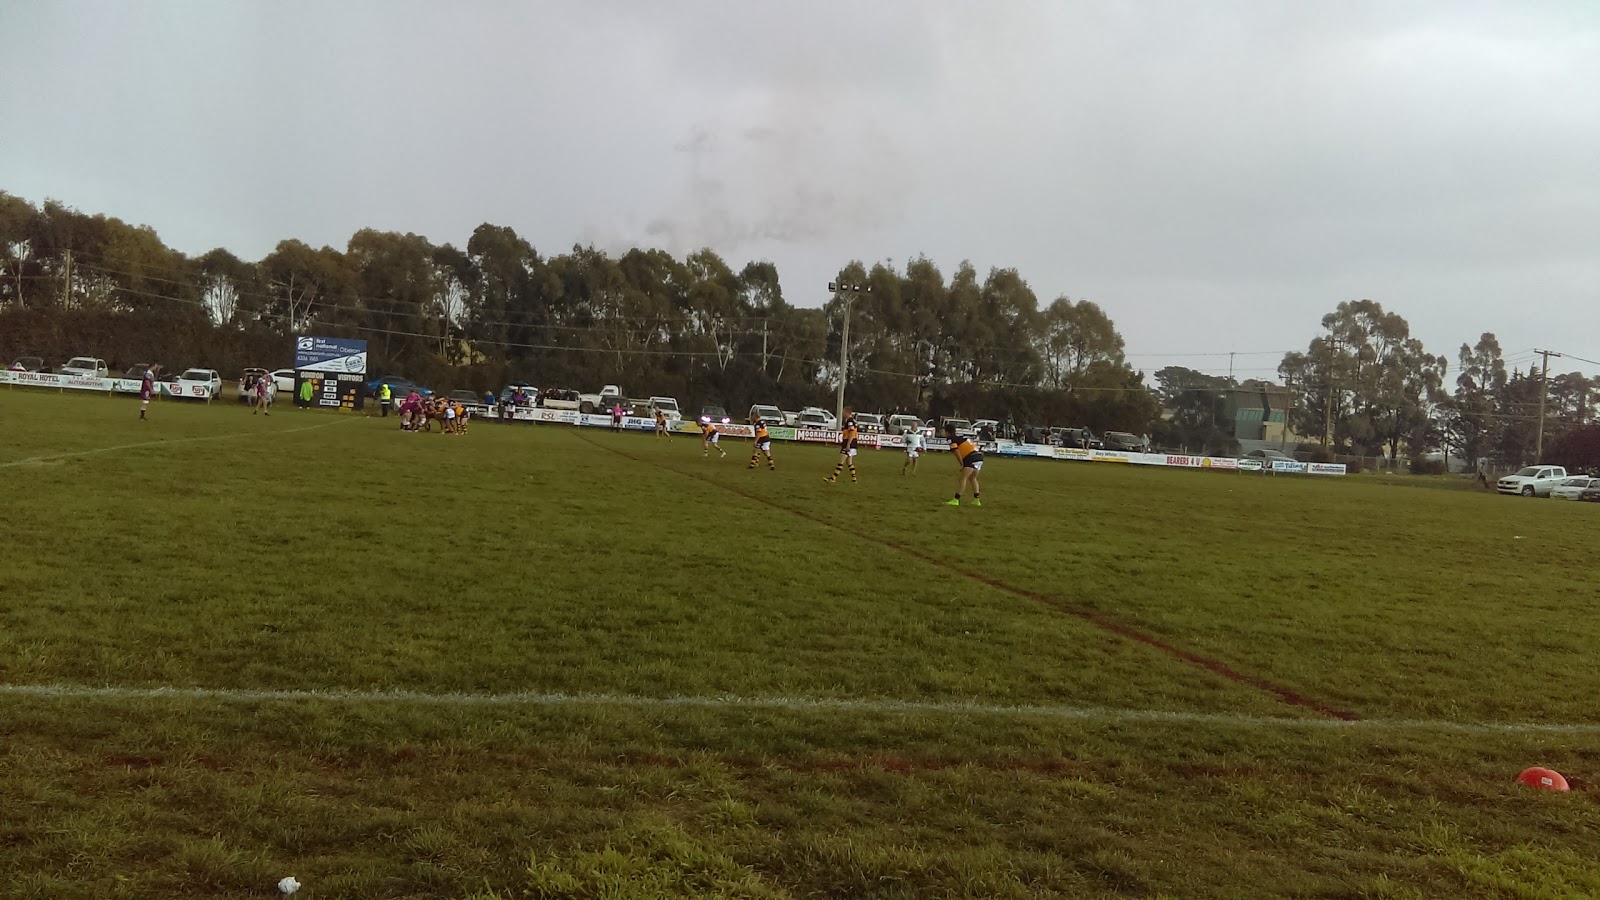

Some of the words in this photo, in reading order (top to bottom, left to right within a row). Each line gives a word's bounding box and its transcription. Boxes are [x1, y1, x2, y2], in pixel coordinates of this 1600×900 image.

[18, 372, 38, 380] ROYAL
[39, 374, 60, 382] HOTEL
[300, 371, 325, 379] OBERON
[338, 374, 363, 382] VISITORS
[541, 412, 556, 420] RSL
[797, 430, 836, 440] MOORHEAD
[1166, 456, 1190, 465] BEARERS
